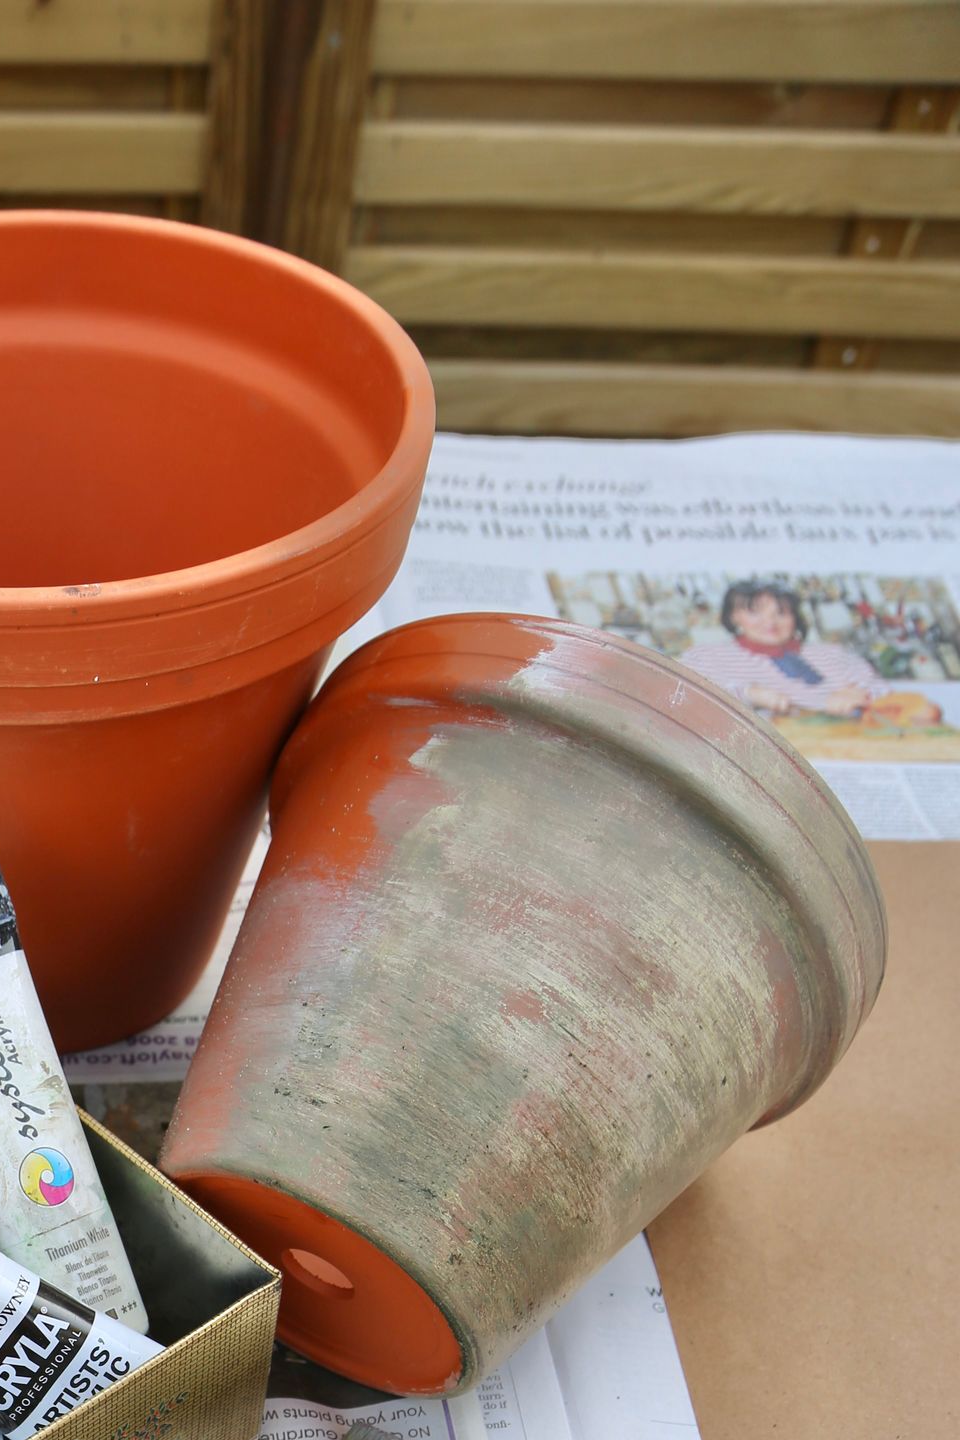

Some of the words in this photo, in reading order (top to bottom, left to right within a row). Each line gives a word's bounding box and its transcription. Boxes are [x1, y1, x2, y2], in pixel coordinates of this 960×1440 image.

[45, 1240, 88, 1262] Titanium
[86, 1227, 110, 1244] White
[9, 1329, 82, 1421] PROFESSIONAL
[284, 1408, 331, 1423] plants
[392, 1406, 426, 1421] Your
[408, 1426, 430, 1439] No
